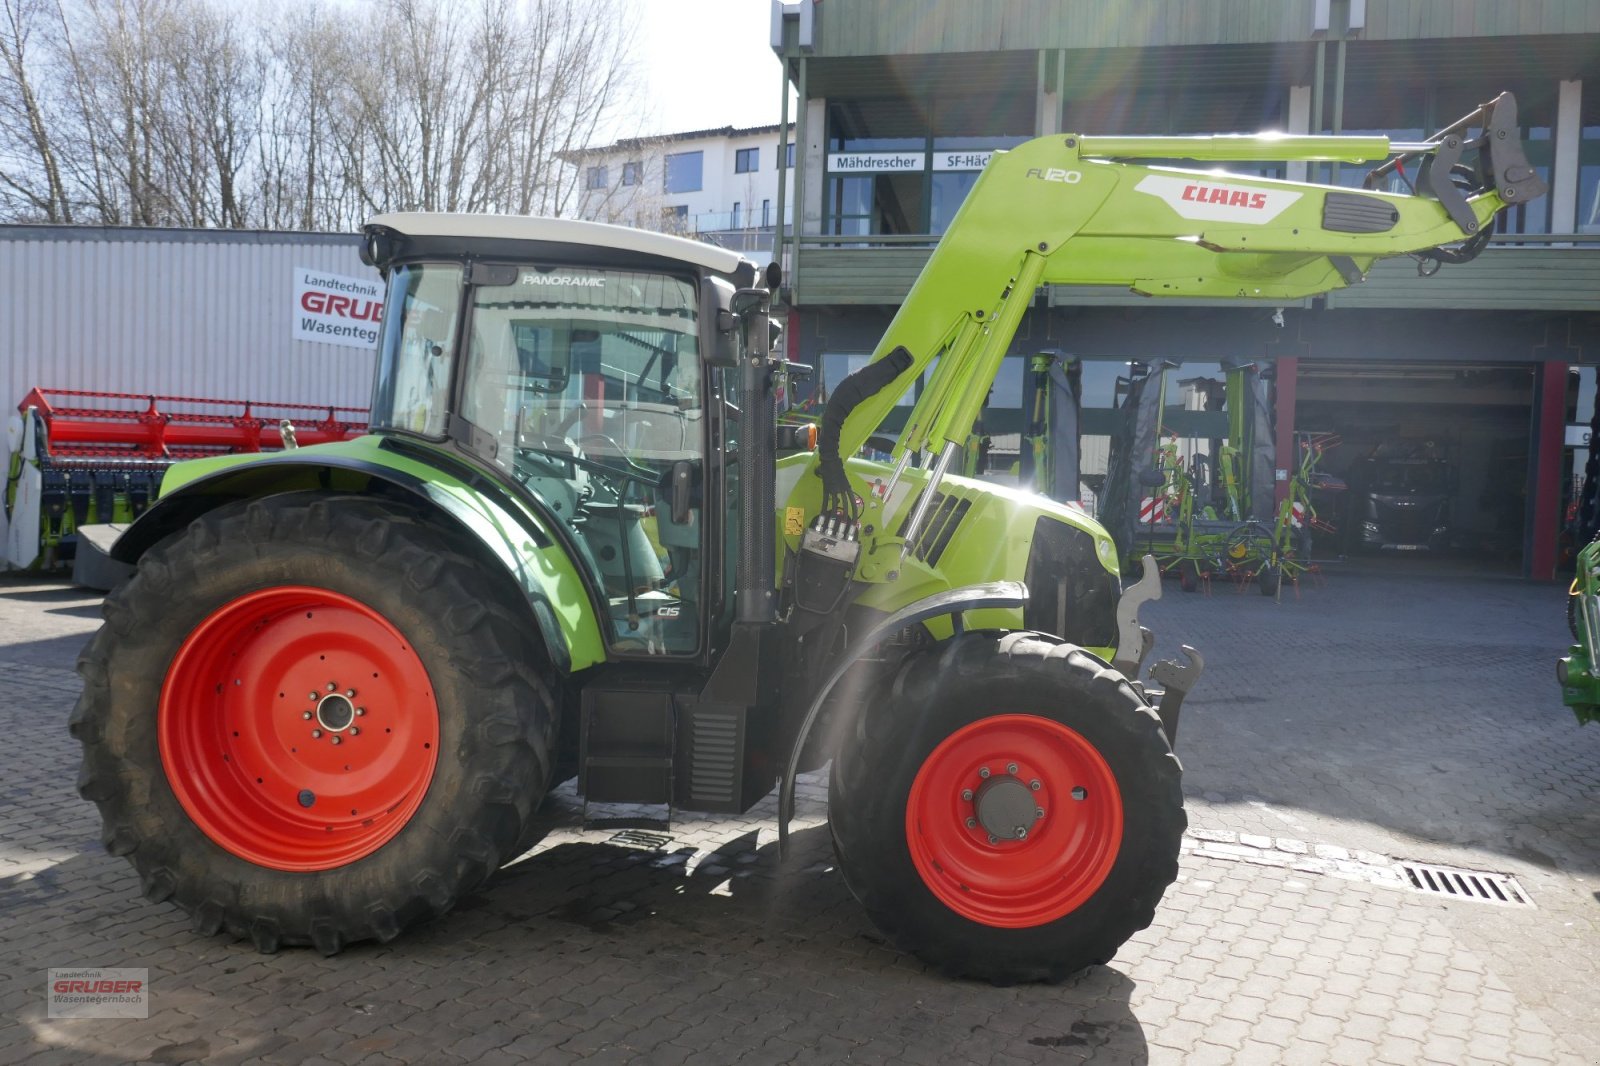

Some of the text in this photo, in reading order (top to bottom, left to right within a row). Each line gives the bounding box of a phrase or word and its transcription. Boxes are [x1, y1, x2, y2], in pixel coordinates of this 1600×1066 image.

[837, 156, 916, 168] Mähdrescher
[947, 155, 991, 167] SF-Häc
[1026, 168, 1082, 184] FL120
[1182, 185, 1267, 209] CLAAS
[304, 274, 377, 297] Landtechnik
[522, 275, 606, 287] PANORAMIC
[301, 317, 379, 344] Wasenteg
[657, 607, 680, 617] CIS
